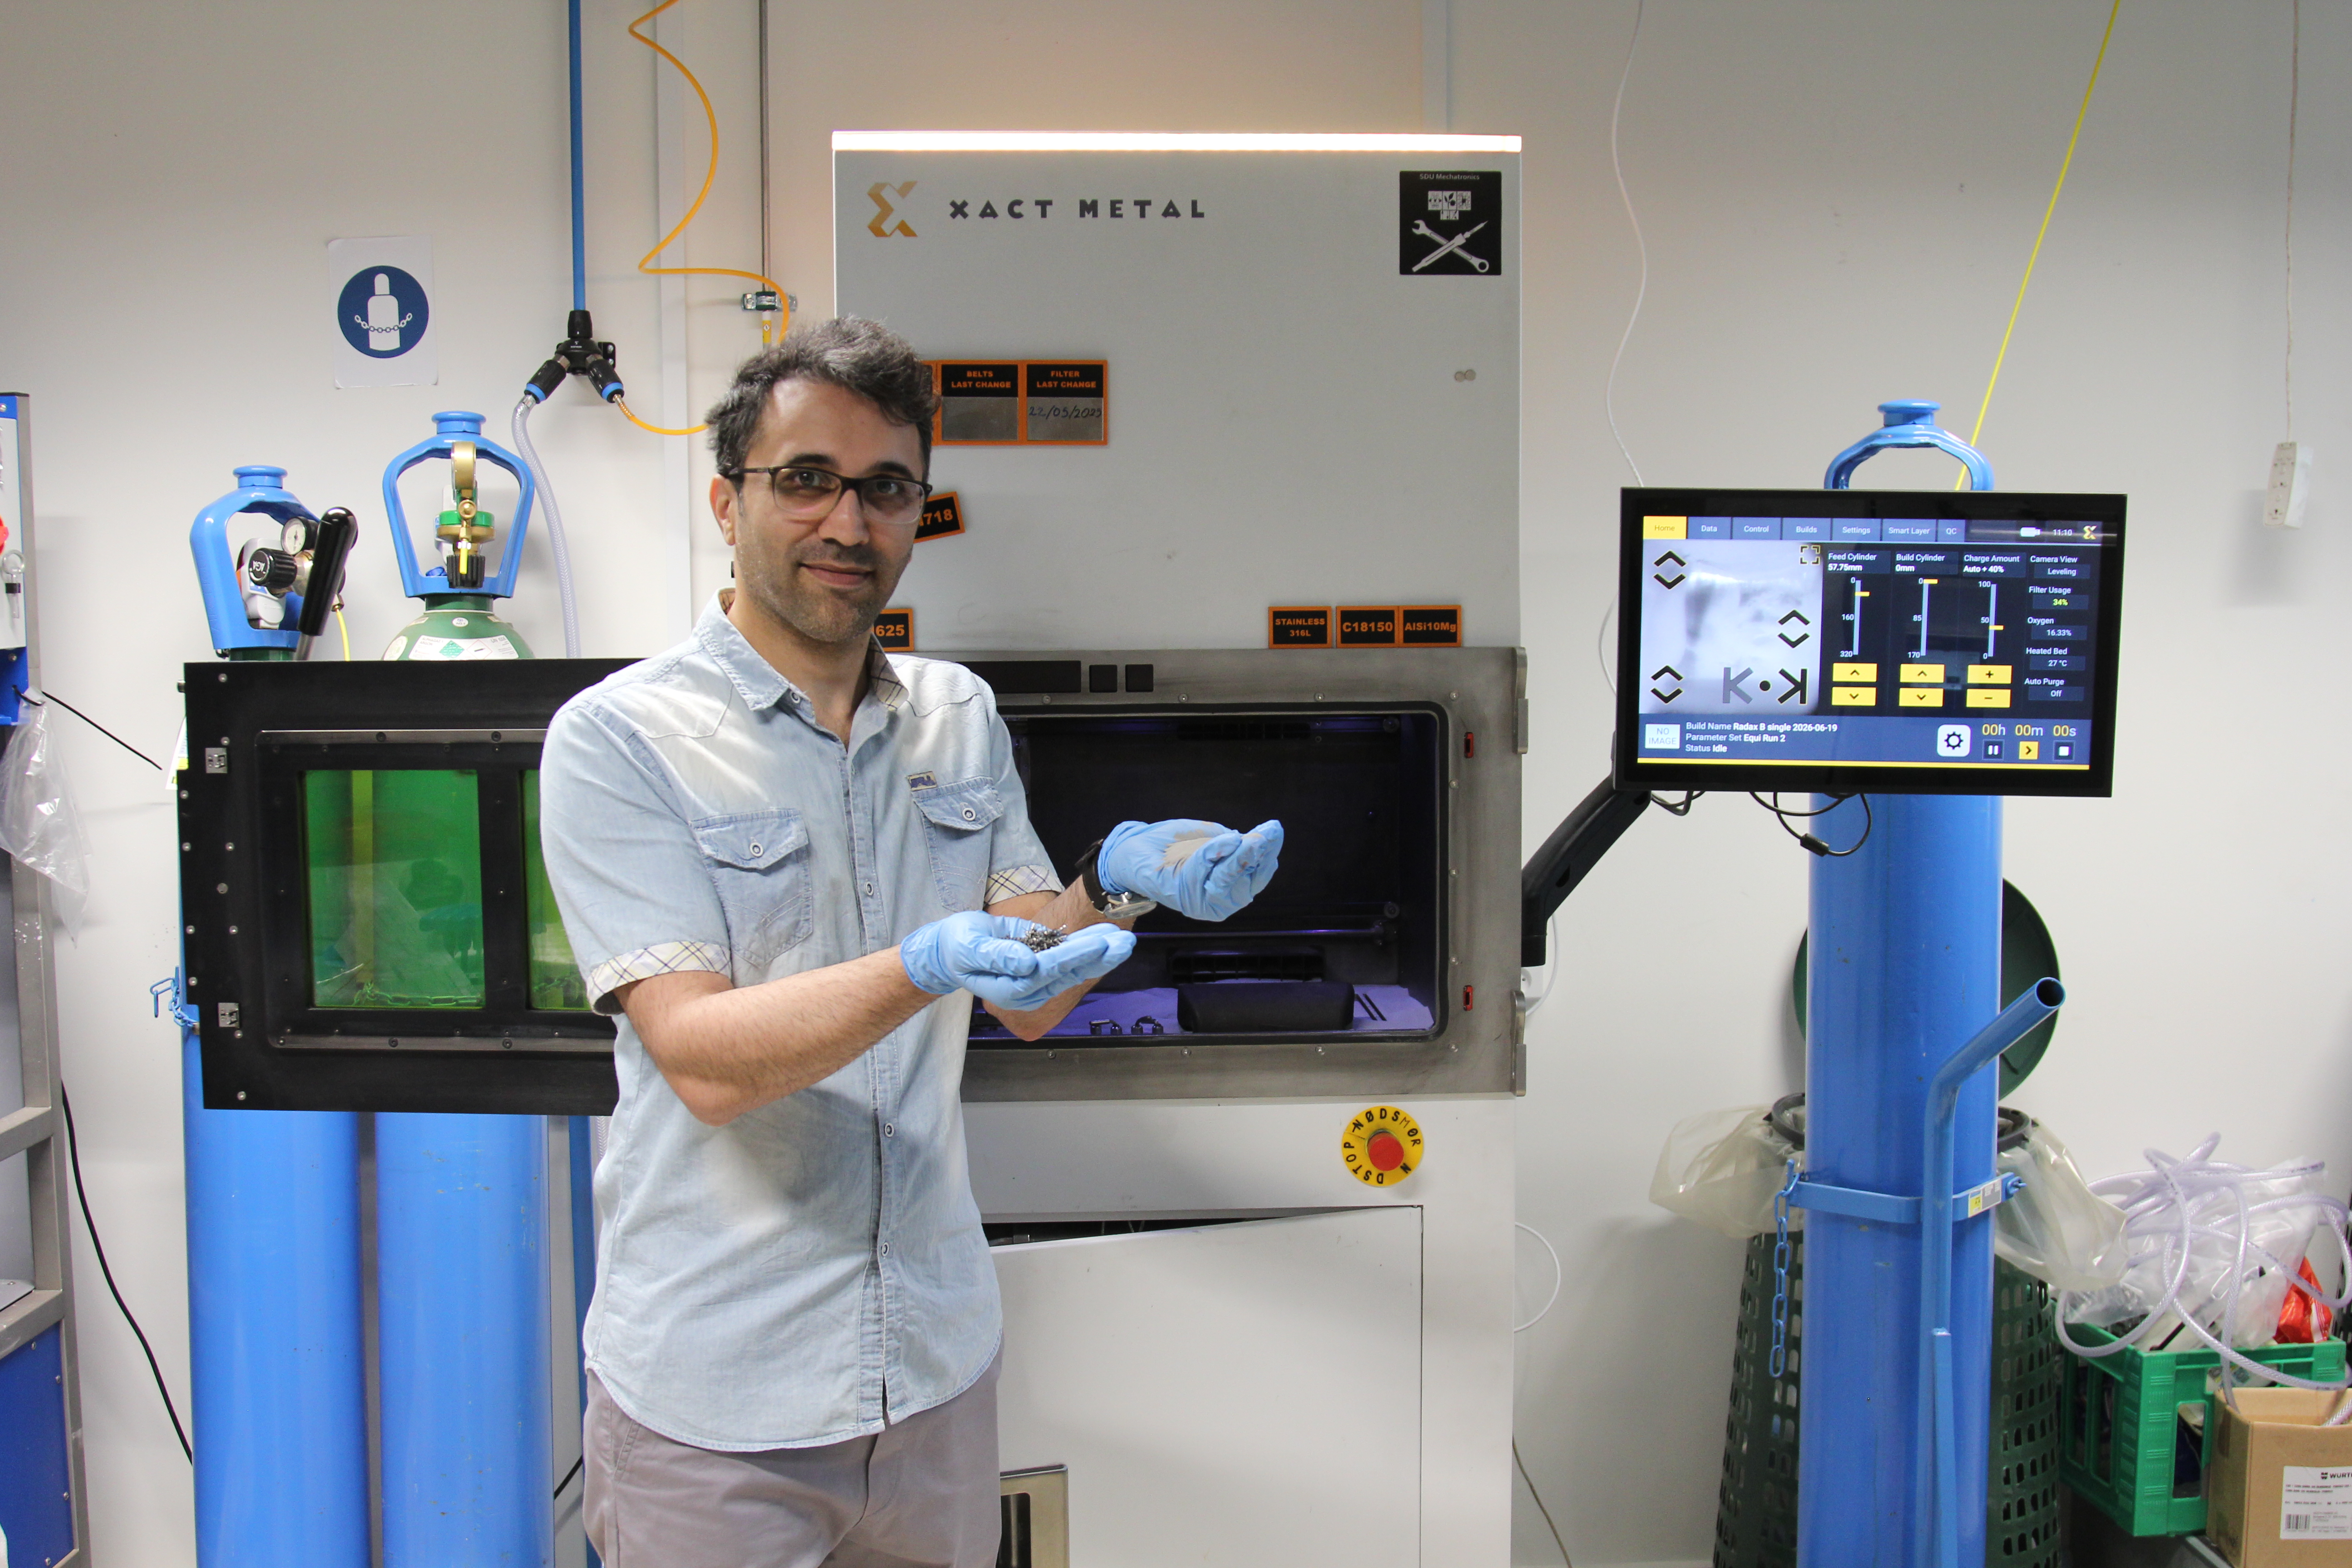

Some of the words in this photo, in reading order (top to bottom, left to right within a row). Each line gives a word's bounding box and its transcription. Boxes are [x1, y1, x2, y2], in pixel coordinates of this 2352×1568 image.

[949, 199, 1053, 219] XACT
[1079, 199, 1205, 219] METAL
[1842, 526, 1871, 535] Settings
[1911, 527, 1930, 535] Layer
[1848, 553, 1877, 562] Cylinder
[1916, 554, 1945, 563] Cylinder
[1964, 555, 1990, 563] Charge
[2048, 568, 2077, 576] Leveling
[2049, 586, 2072, 595] Usage
[2027, 617, 2054, 626] Oxygen
[1342, 622, 1393, 632] C18150
[2043, 678, 2065, 687] Purge
[1686, 722, 1706, 730] Build
[1768, 723, 1791, 732] single
[1792, 723, 1838, 732] 2026-06-19
[1982, 723, 2006, 736] 00h
[2015, 724, 2043, 736] 00m
[2053, 725, 2077, 737] 00s
[1744, 734, 1761, 743] Equi
[1685, 744, 1711, 752] Status
